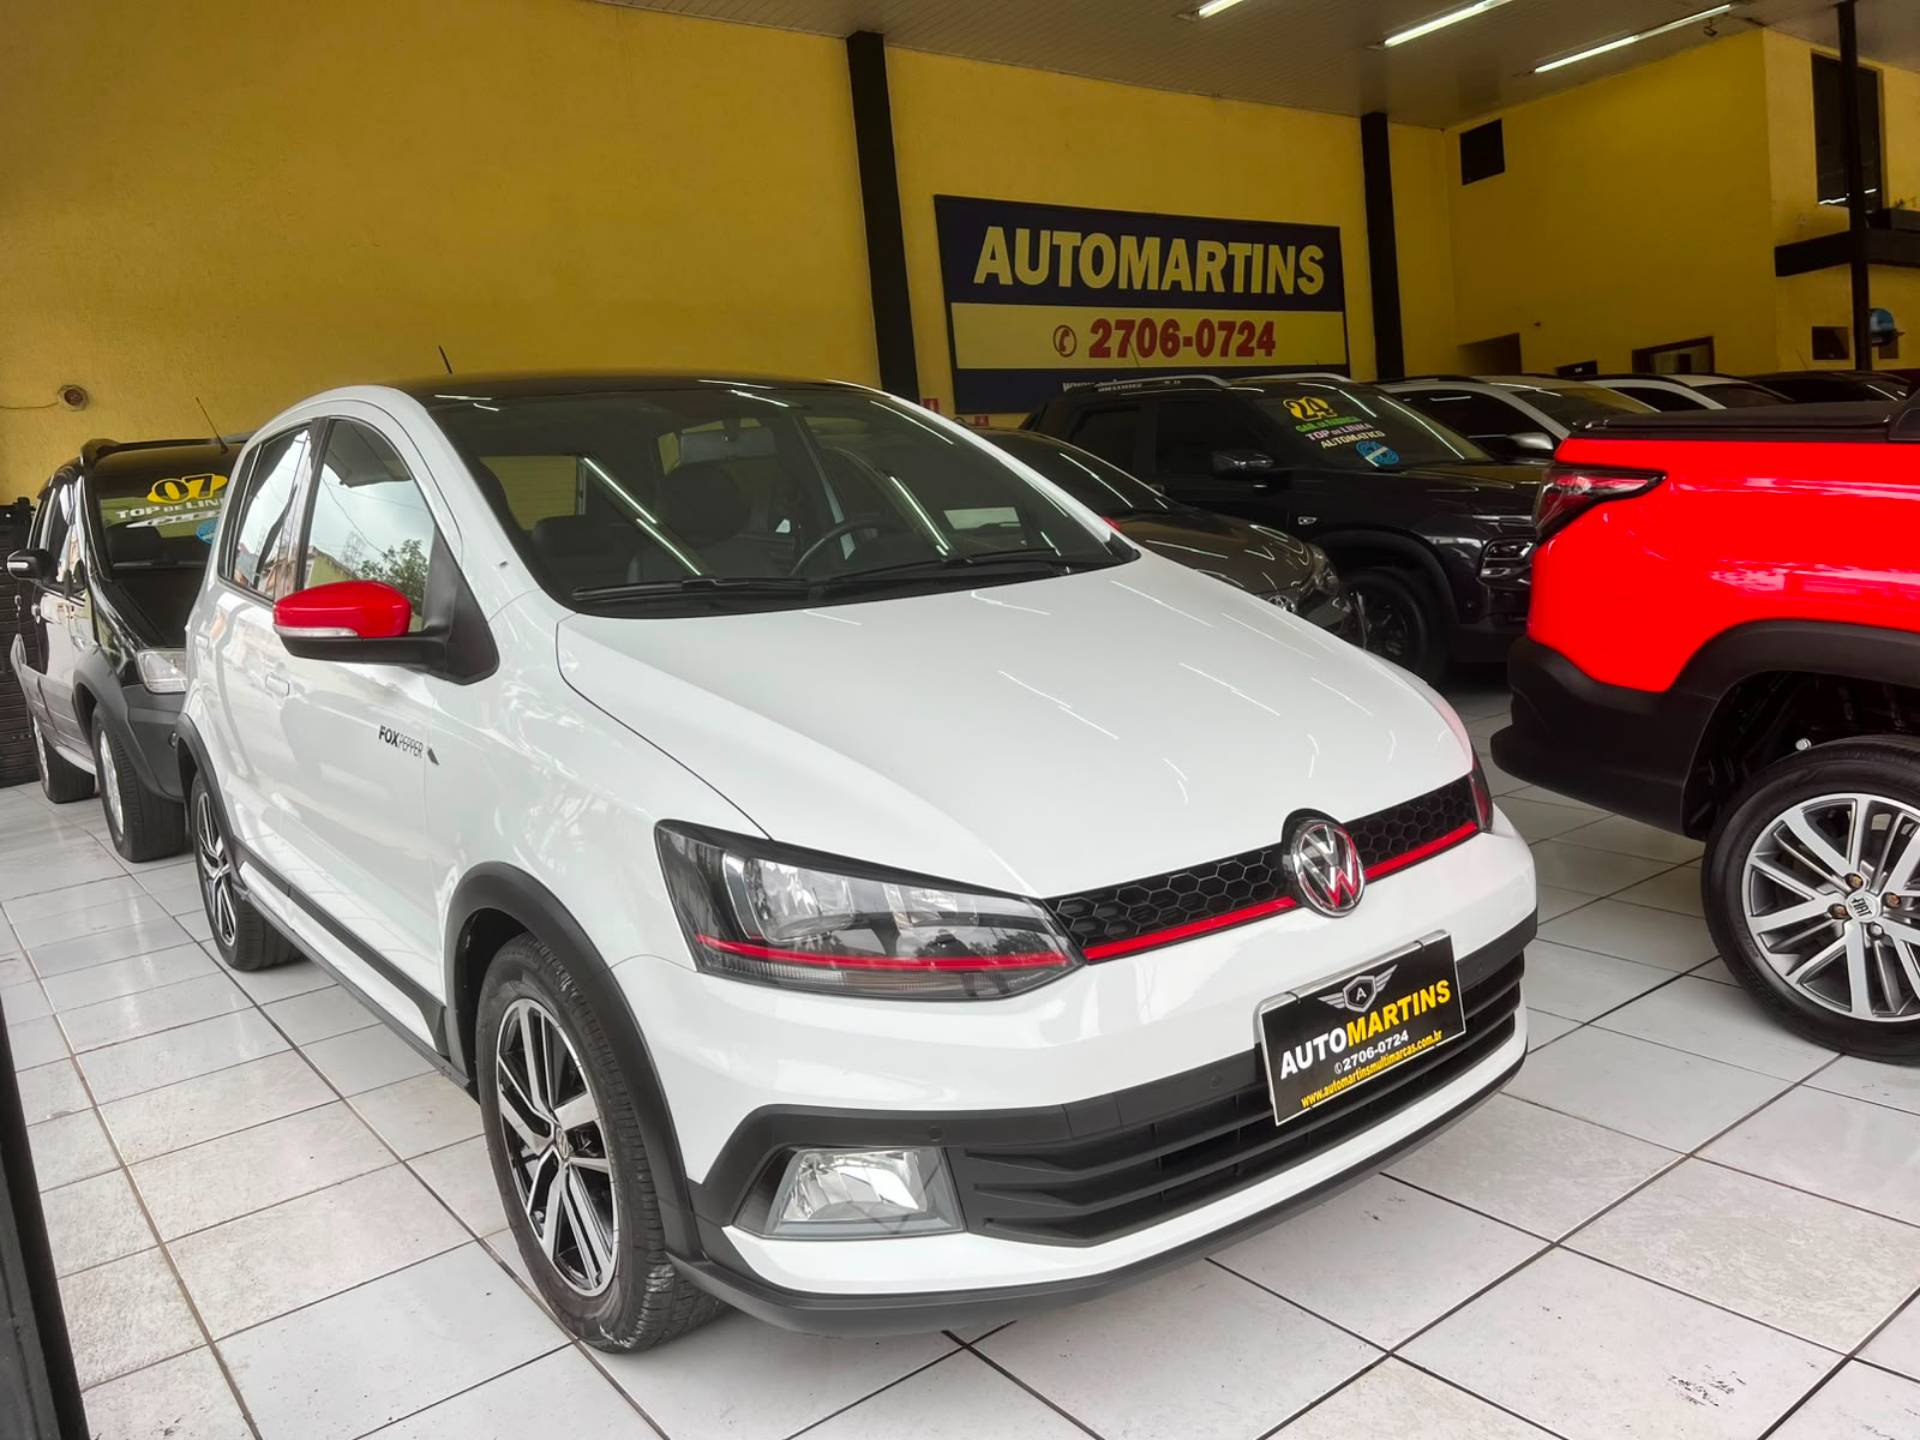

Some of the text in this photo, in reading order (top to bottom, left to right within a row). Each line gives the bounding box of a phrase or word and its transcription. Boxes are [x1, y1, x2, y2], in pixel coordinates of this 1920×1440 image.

[973, 226, 1325, 295] AUTOMARTINS
[1088, 317, 1277, 359] 2706-0724
[1305, 429, 1331, 441] TOP
[152, 473, 216, 504] 07
[115, 505, 160, 519] TOP
[1851, 897, 1872, 917] FIAT
[1280, 979, 1452, 1080] AUTOMARTINS
[1342, 1029, 1409, 1072] 2706-0724
[1301, 1028, 1443, 1108] www.automartinsmultimarcas.com.br
